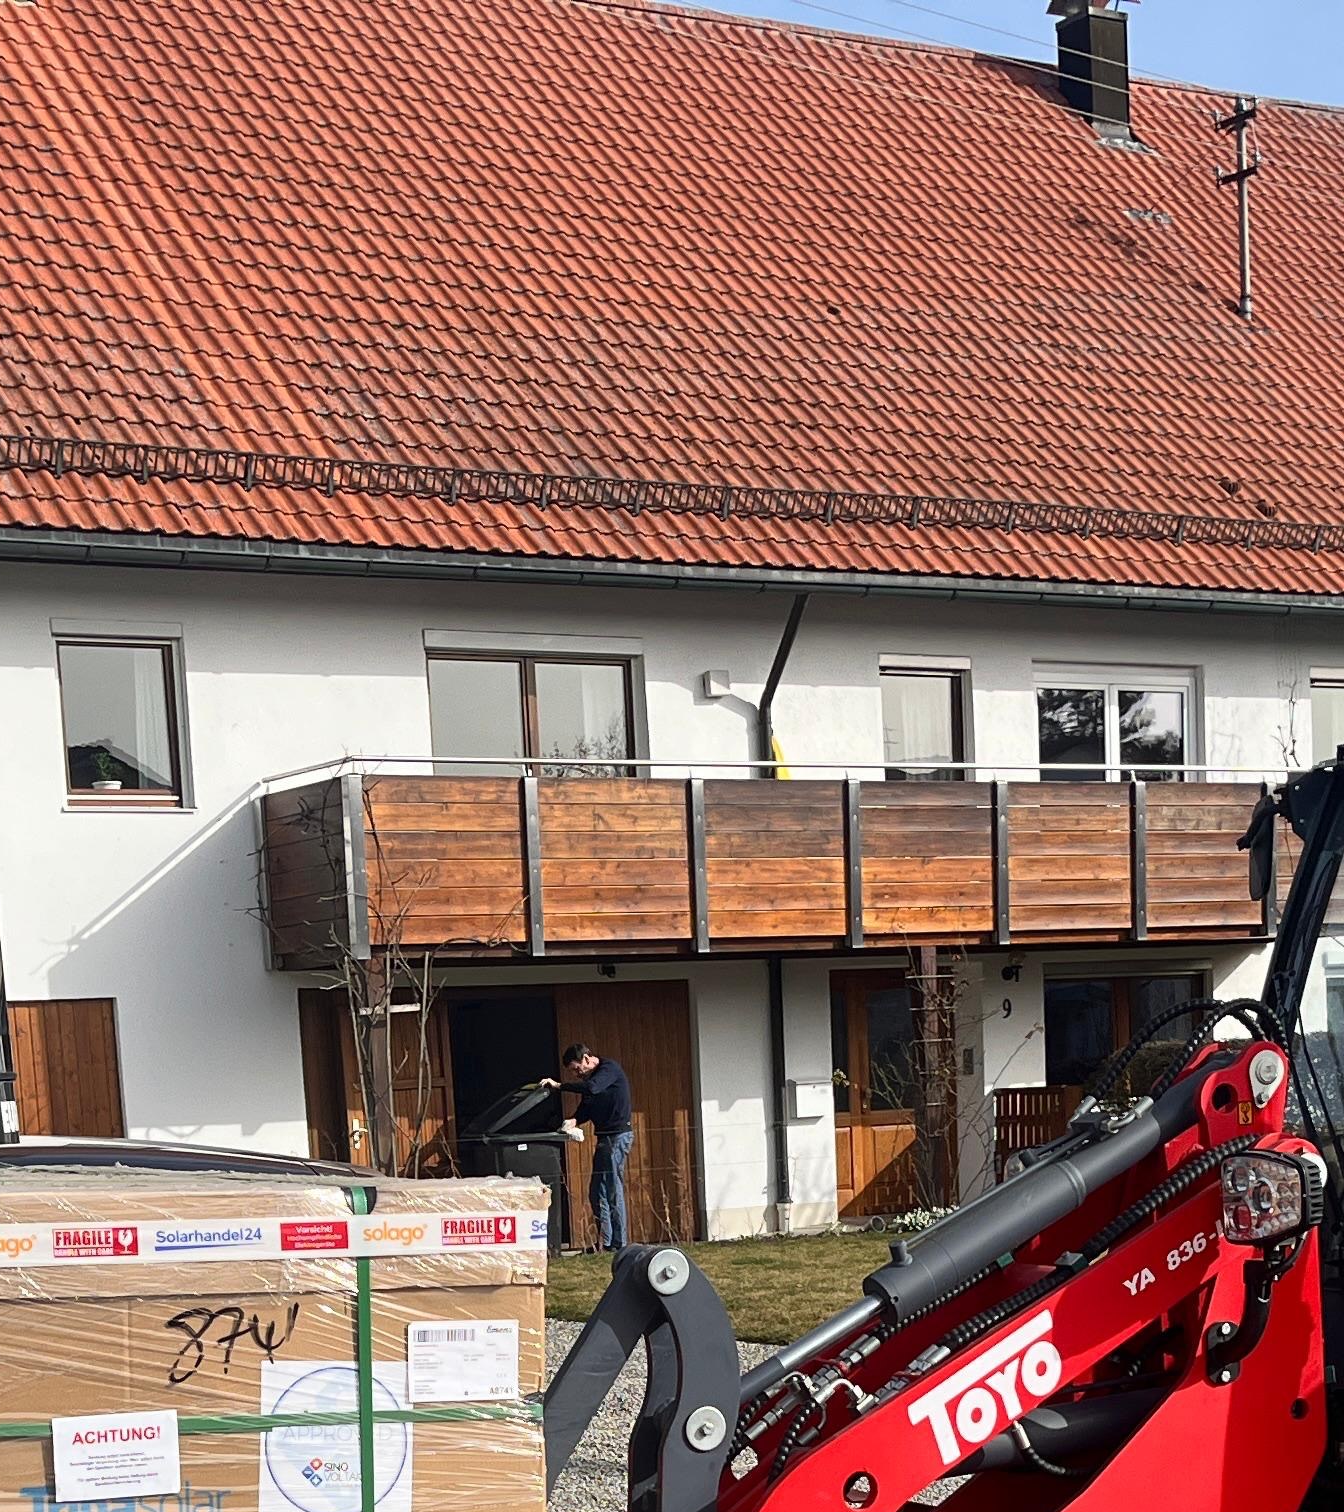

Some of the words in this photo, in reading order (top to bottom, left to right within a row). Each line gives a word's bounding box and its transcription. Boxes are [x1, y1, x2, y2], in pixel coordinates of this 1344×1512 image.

[1003, 998, 1011, 1018] 9
[156, 1228, 262, 1243] Solarhandel24
[444, 1220, 492, 1234] FRAGILE
[56, 1229, 112, 1247] FRAGILE
[1122, 1268, 1156, 1296] YA
[72, 1426, 161, 1446] ACHTUNG!
